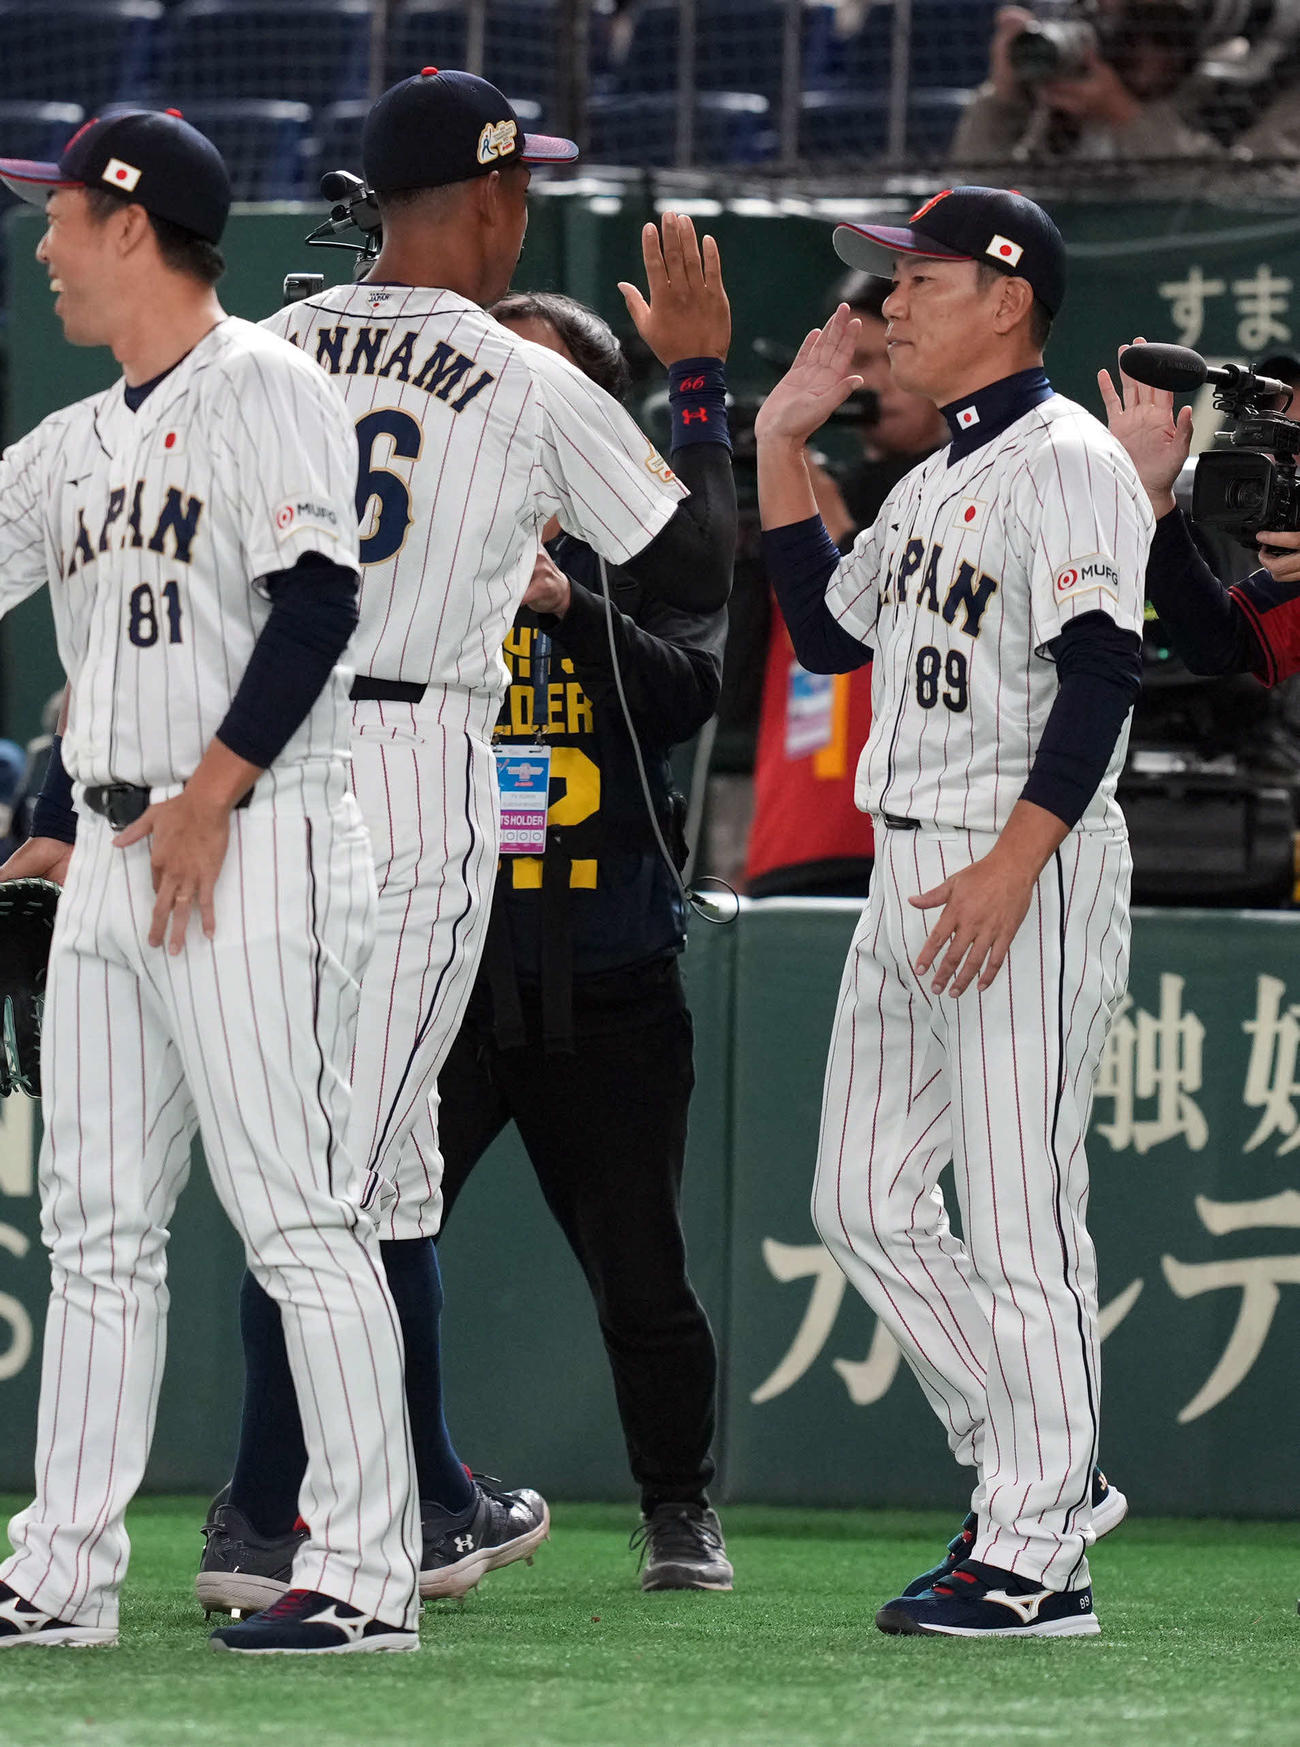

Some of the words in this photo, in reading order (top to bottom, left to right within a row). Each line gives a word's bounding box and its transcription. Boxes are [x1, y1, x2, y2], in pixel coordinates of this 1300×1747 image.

[1158, 265, 1293, 350] すま
[288, 325, 497, 414] NNAMI
[680, 375, 706, 392] 66
[354, 405, 425, 567] 6
[1081, 563, 1119, 587] MUFG
[128, 580, 183, 648] 81
[915, 645, 968, 713] 89
[511, 815, 544, 826] HOLDER
[1079, 1595, 1090, 1610] 89
